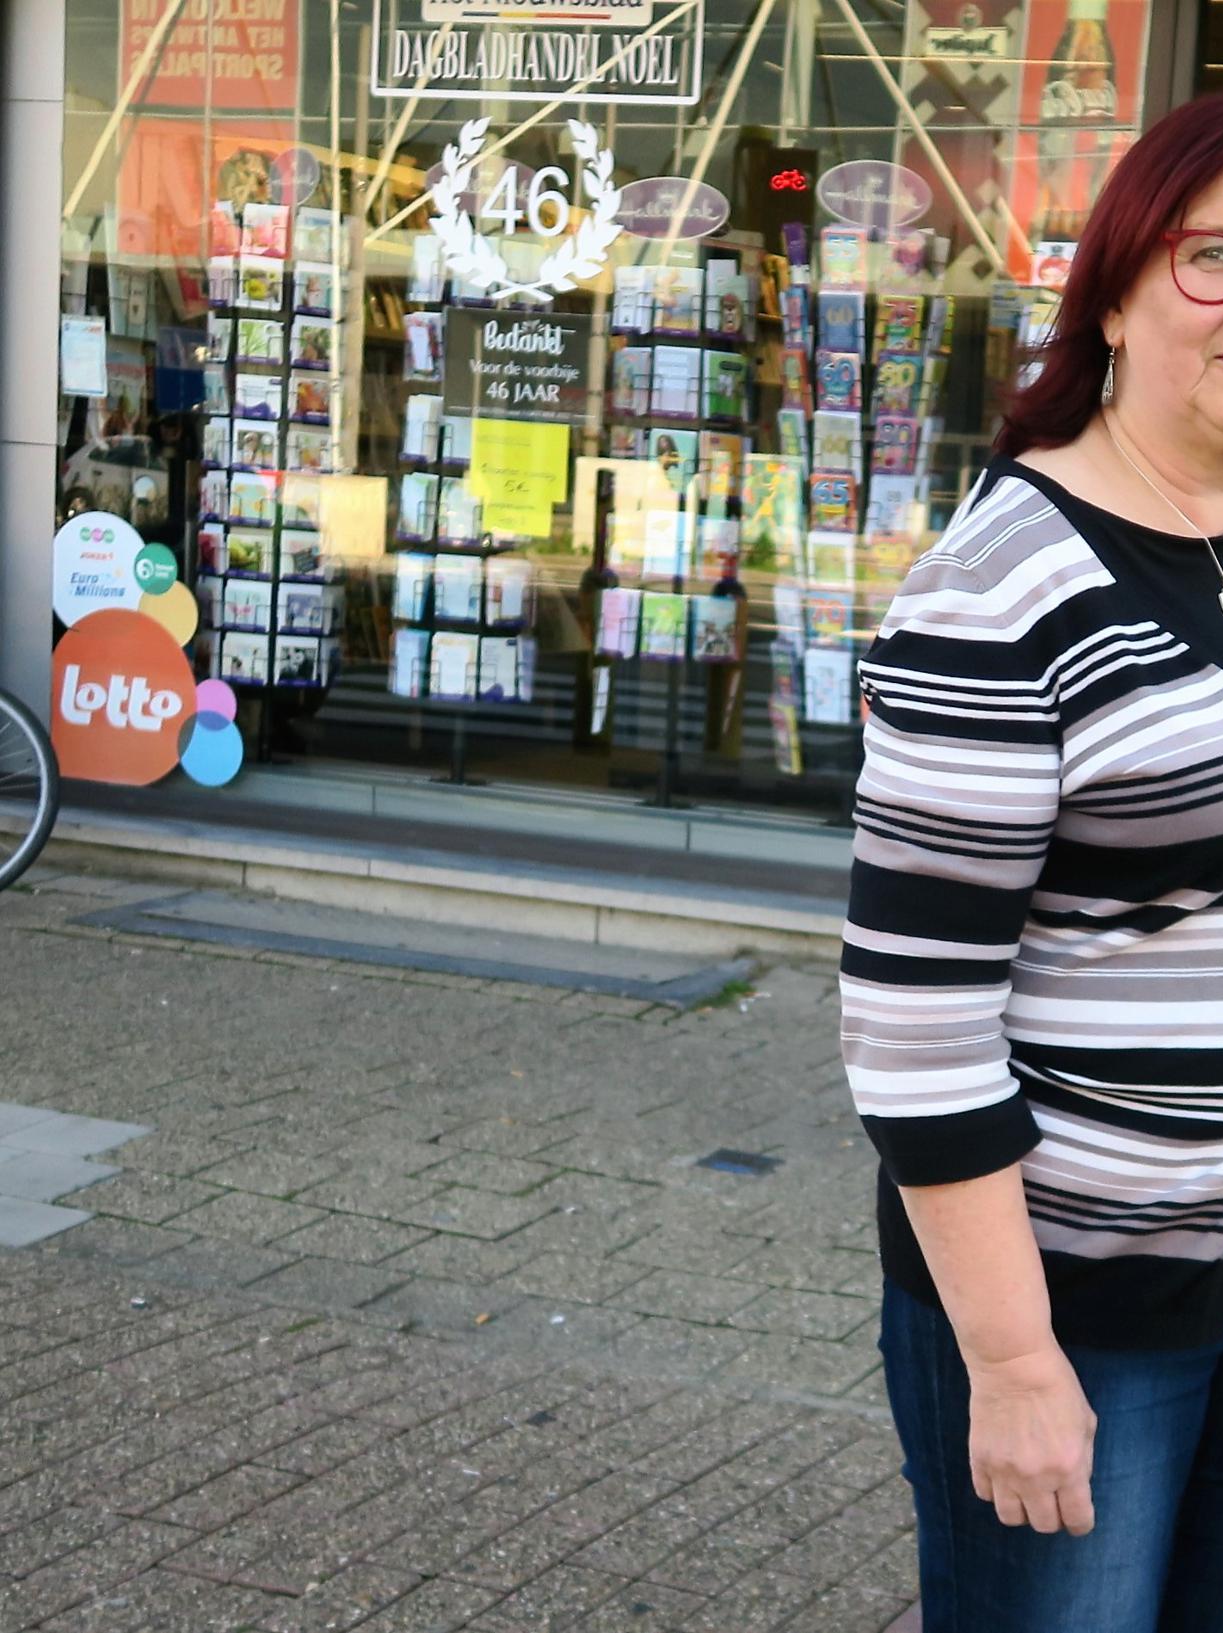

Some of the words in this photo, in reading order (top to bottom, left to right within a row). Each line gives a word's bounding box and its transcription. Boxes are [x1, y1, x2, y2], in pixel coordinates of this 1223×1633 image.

[393, 29, 606, 84] DAGBLADHANDEL
[480, 165, 570, 237] 46
[503, 359, 522, 376] de
[485, 381, 510, 400] 46
[513, 382, 561, 404] JAAR
[812, 480, 850, 505] 65
[70, 572, 99, 584] Euro
[74, 585, 127, 598] Millions
